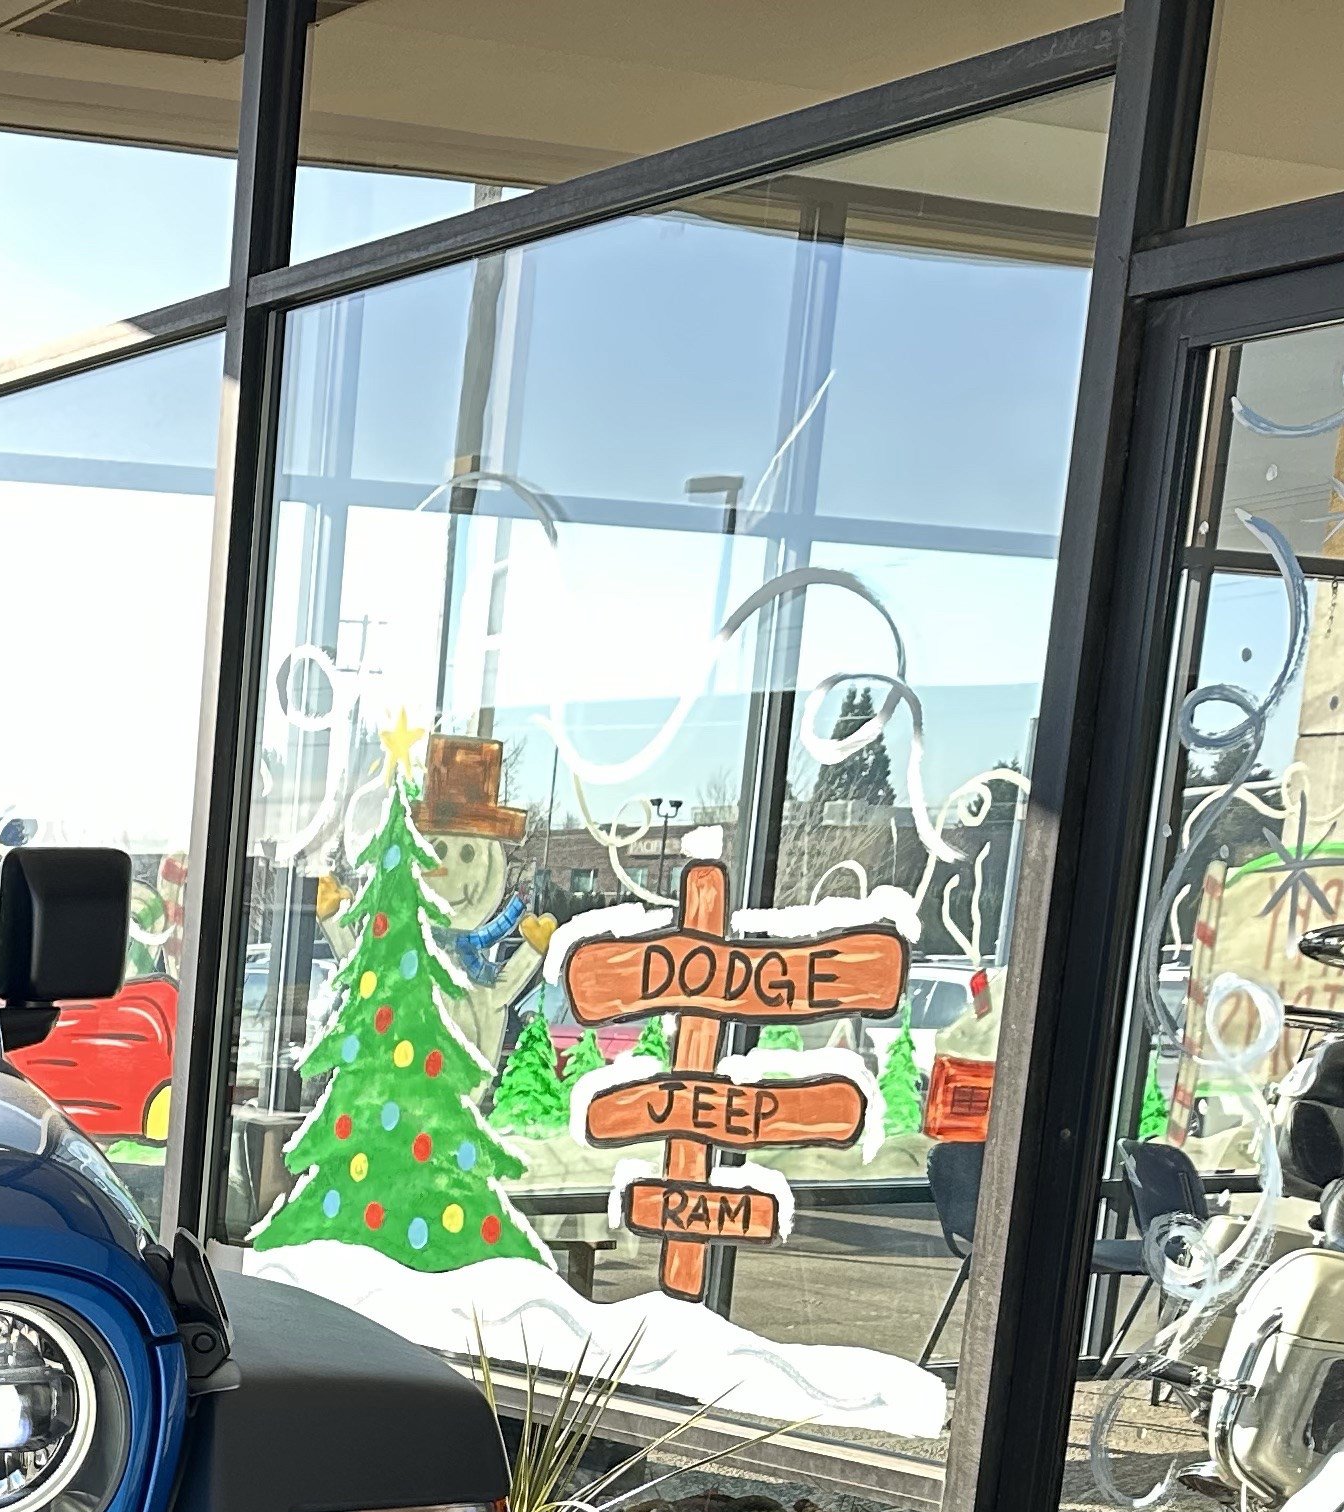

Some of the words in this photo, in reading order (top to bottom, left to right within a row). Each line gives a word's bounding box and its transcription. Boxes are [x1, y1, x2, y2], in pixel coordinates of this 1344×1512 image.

[640, 944, 843, 1011] DODGE
[647, 1081, 779, 1142] JEEP
[661, 1188, 752, 1235] RAM
